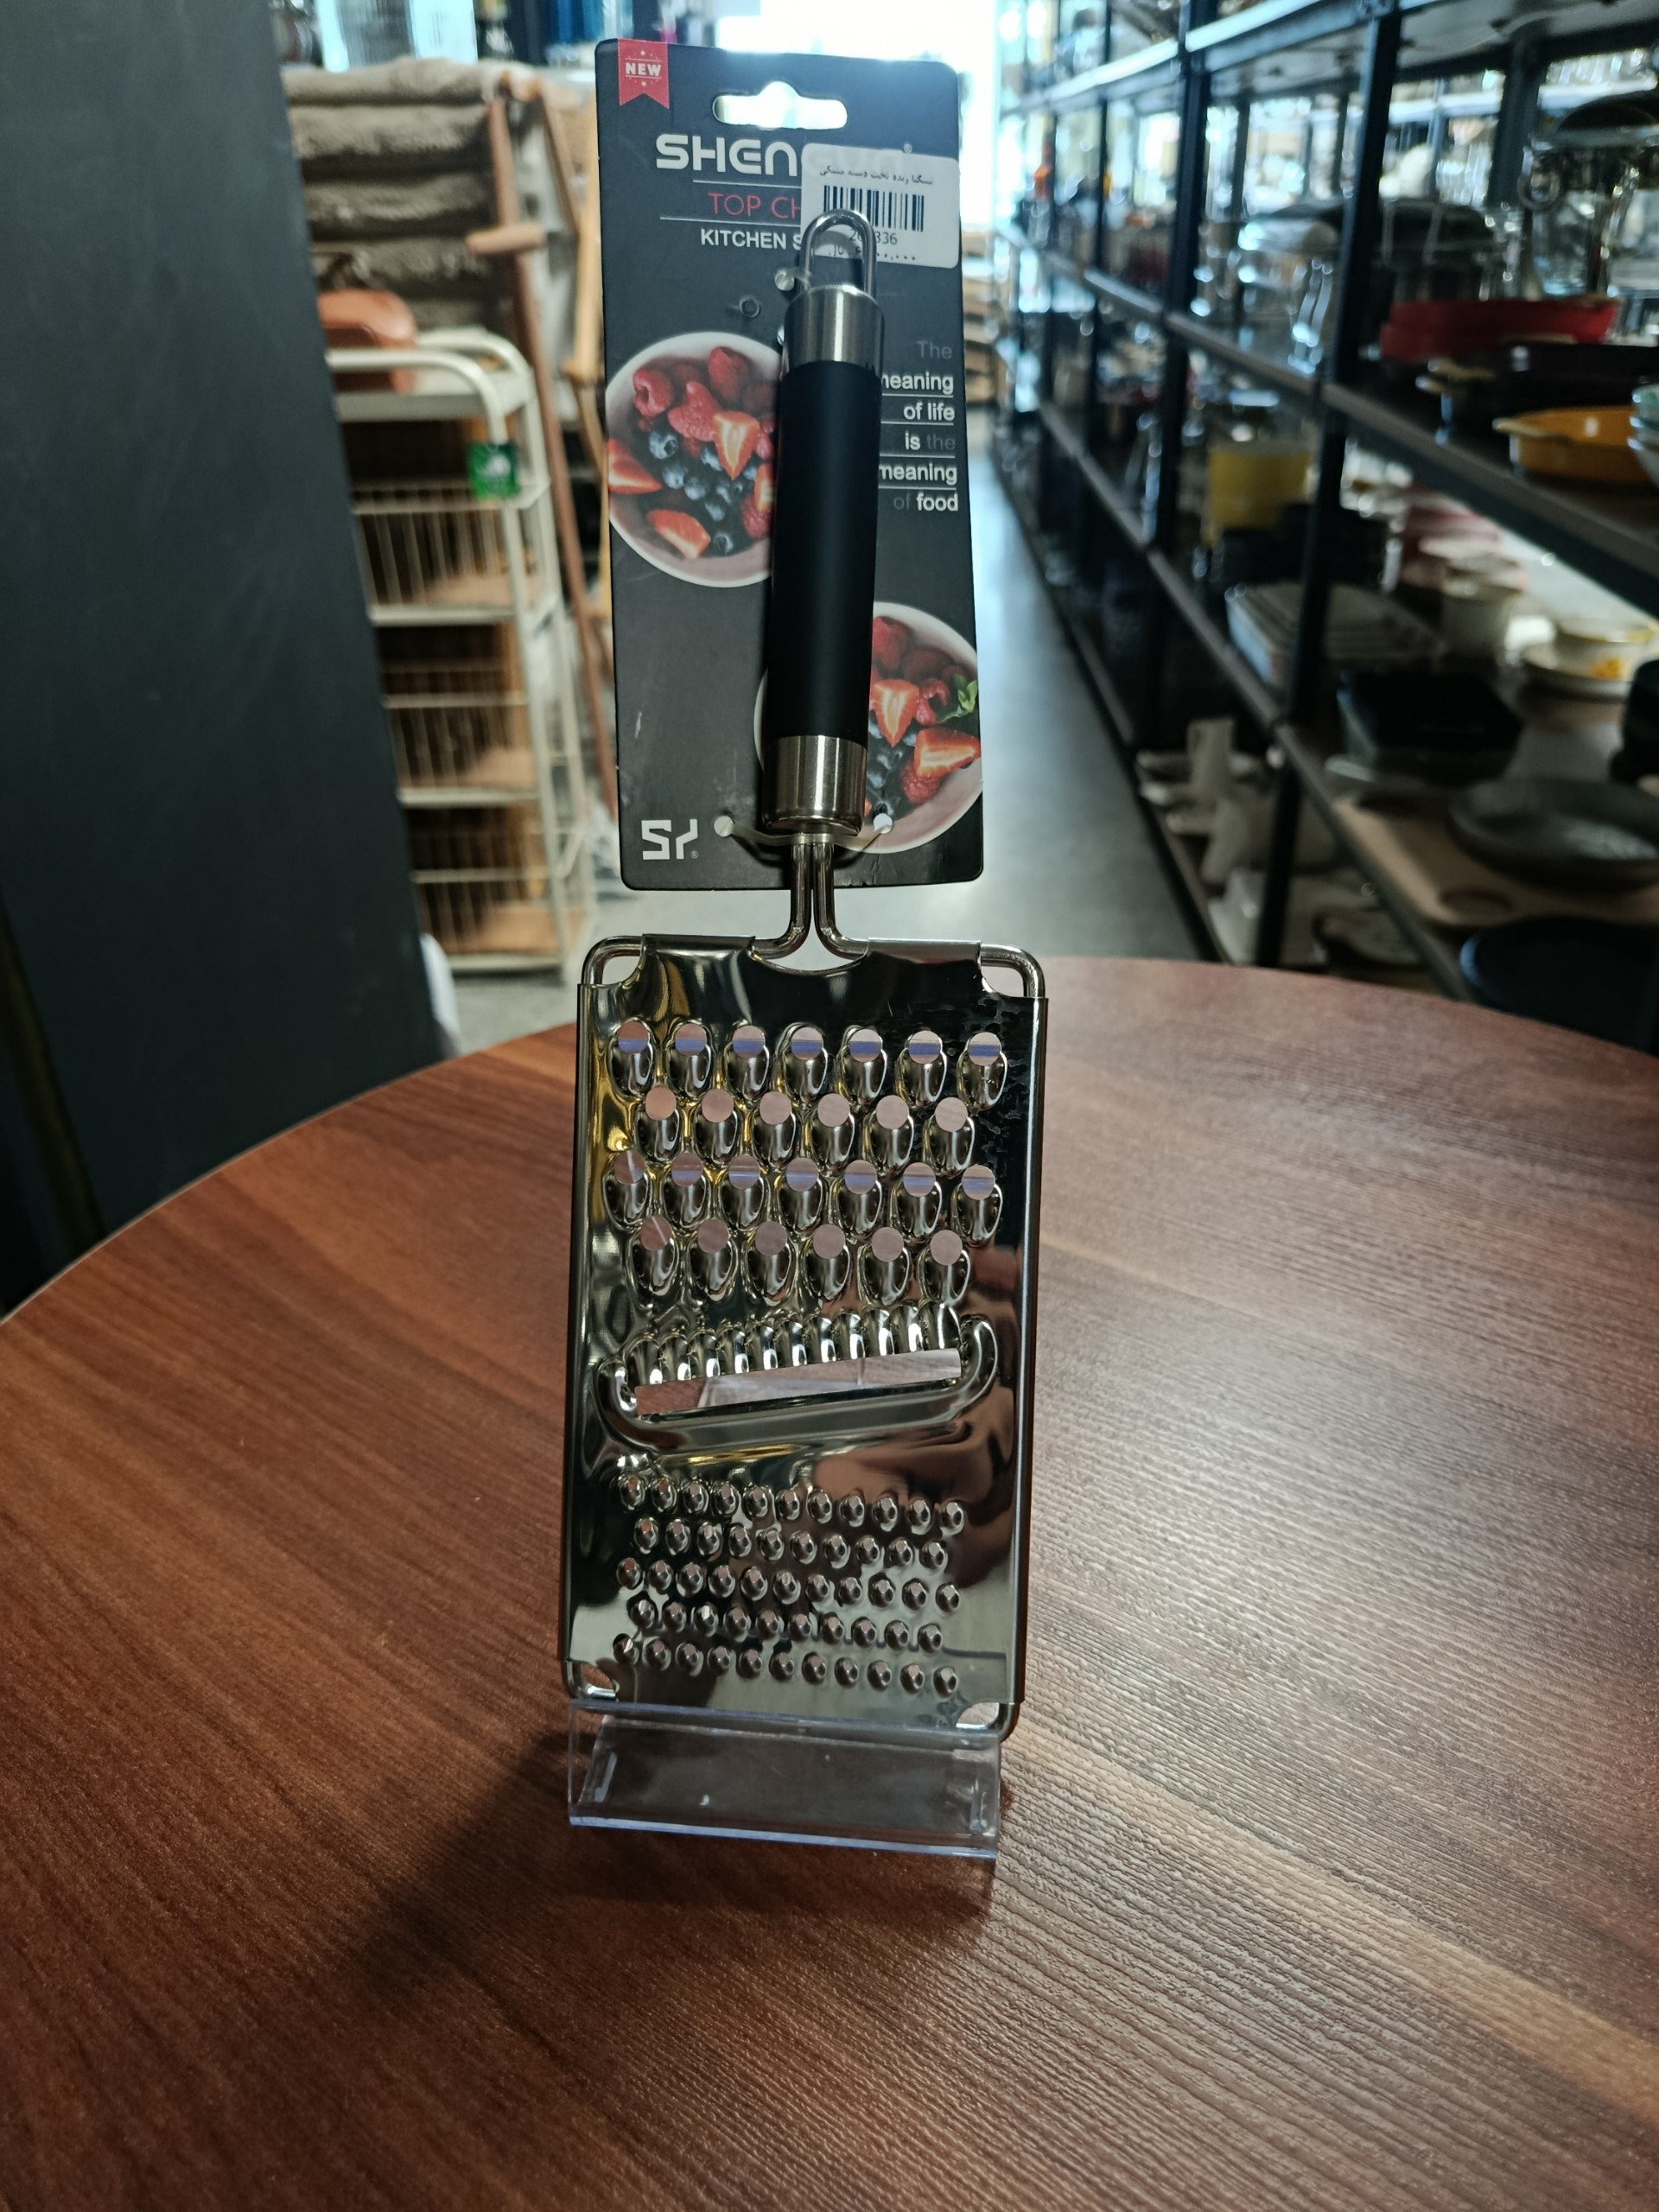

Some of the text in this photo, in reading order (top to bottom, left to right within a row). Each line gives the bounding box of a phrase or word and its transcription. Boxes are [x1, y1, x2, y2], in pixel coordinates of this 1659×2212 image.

[626, 62, 662, 77] NEW
[656, 133, 798, 177] SHEN
[709, 192, 802, 219] TOP CH
[701, 228, 786, 250] KITCHEN
[917, 340, 952, 359] The
[904, 401, 955, 421] of life
[905, 431, 956, 450] is the
[893, 492, 958, 512] of food
